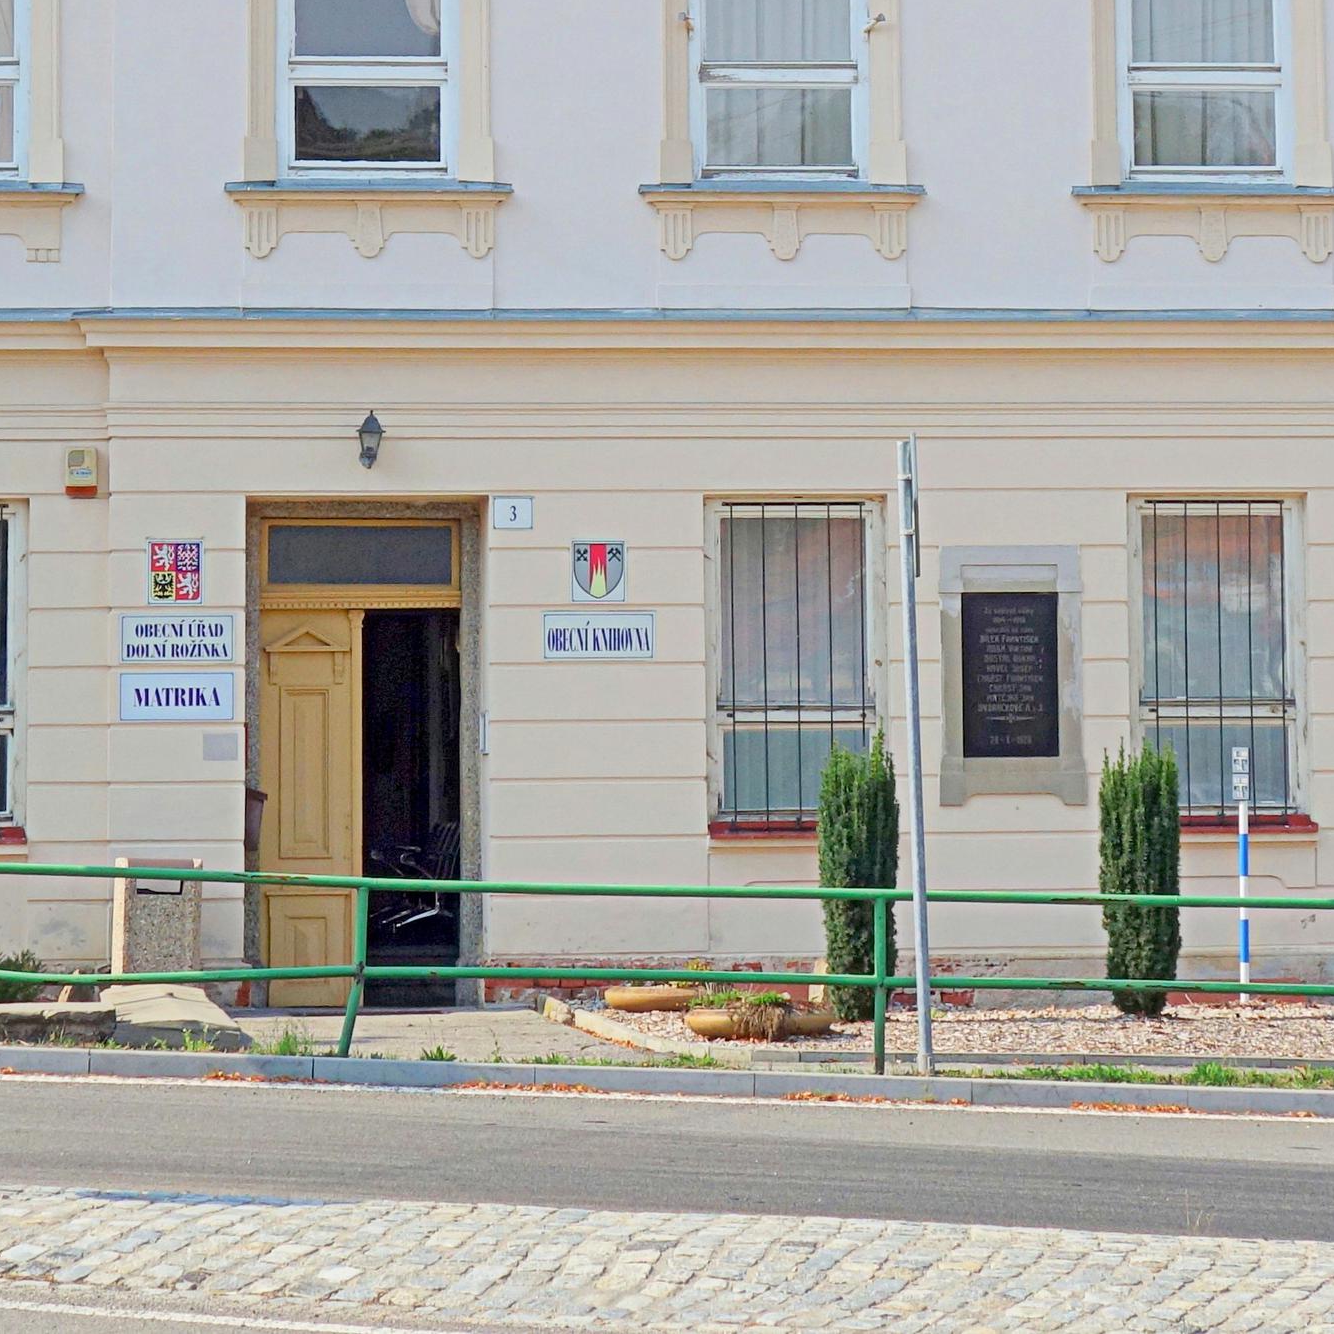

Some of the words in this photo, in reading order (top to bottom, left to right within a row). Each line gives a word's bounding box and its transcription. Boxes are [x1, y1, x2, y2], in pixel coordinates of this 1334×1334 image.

[509, 505, 517, 522] 3
[135, 619, 183, 638] OBECNÍ
[188, 619, 224, 638] ÚŘAD
[547, 620, 590, 652] OBECNÍ
[593, 628, 650, 652] KNIHOVNA
[126, 639, 167, 658] DOLNÍ
[171, 639, 228, 658] ROŽÍNKA
[133, 687, 221, 707] MATRIKA
